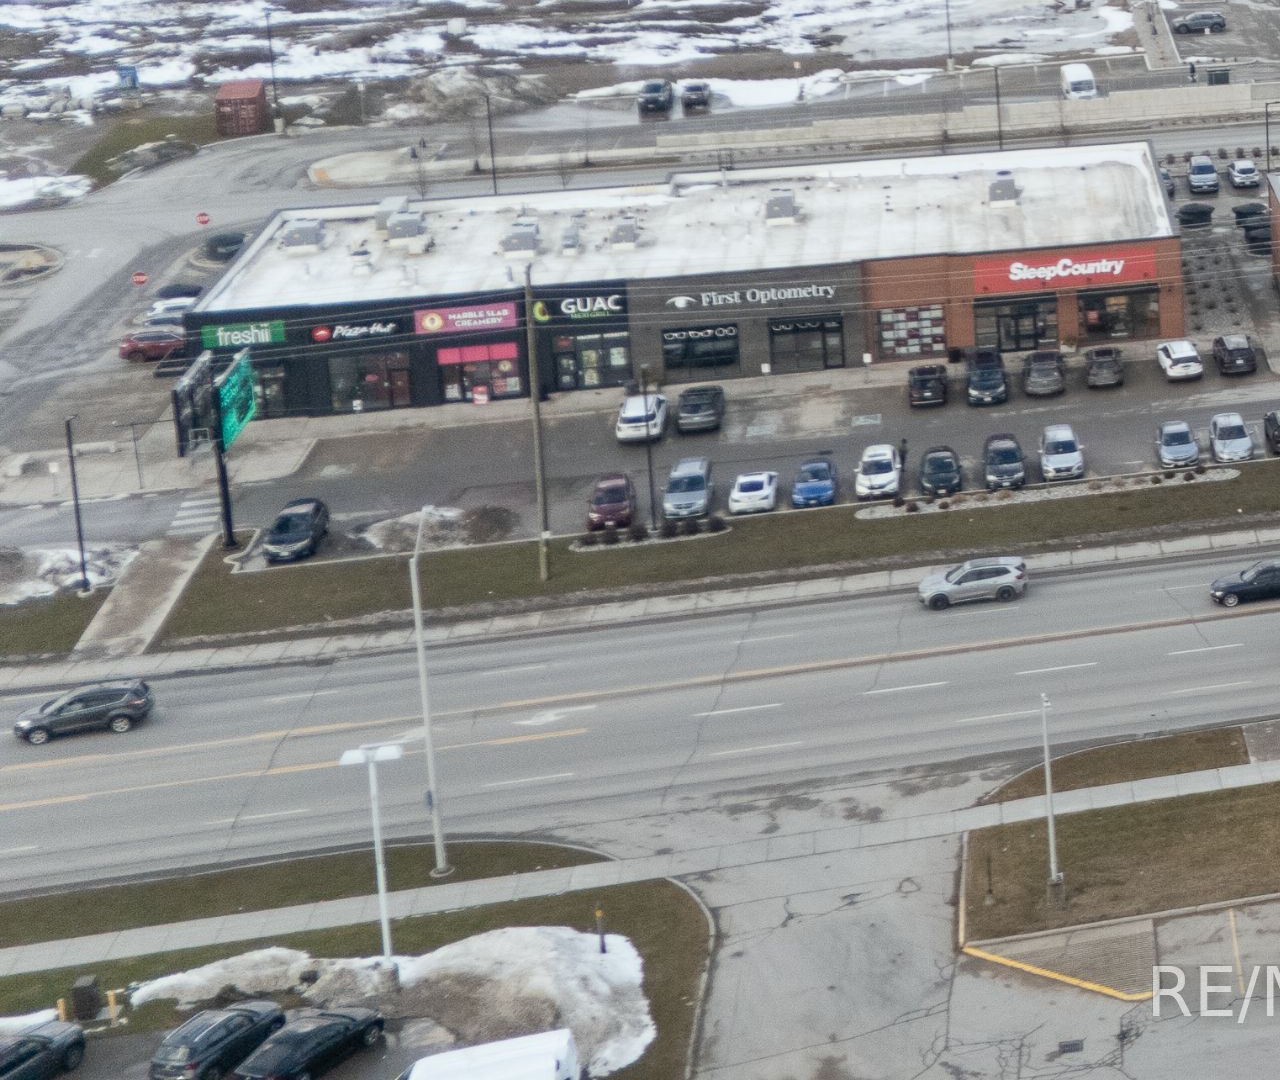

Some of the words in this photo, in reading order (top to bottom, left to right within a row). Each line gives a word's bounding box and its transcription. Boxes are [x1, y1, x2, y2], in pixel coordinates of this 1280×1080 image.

[1008, 258, 1125, 281] SleepCountry
[560, 294, 624, 314] GUAC
[701, 291, 742, 307] First
[746, 284, 837, 304] Optometry
[448, 309, 485, 320] MARBLE
[486, 308, 509, 318] SLAB
[454, 317, 503, 328] CREAMERY
[216, 323, 272, 346] freshii
[332, 325, 367, 339] Pizza
[368, 323, 396, 334] Hut
